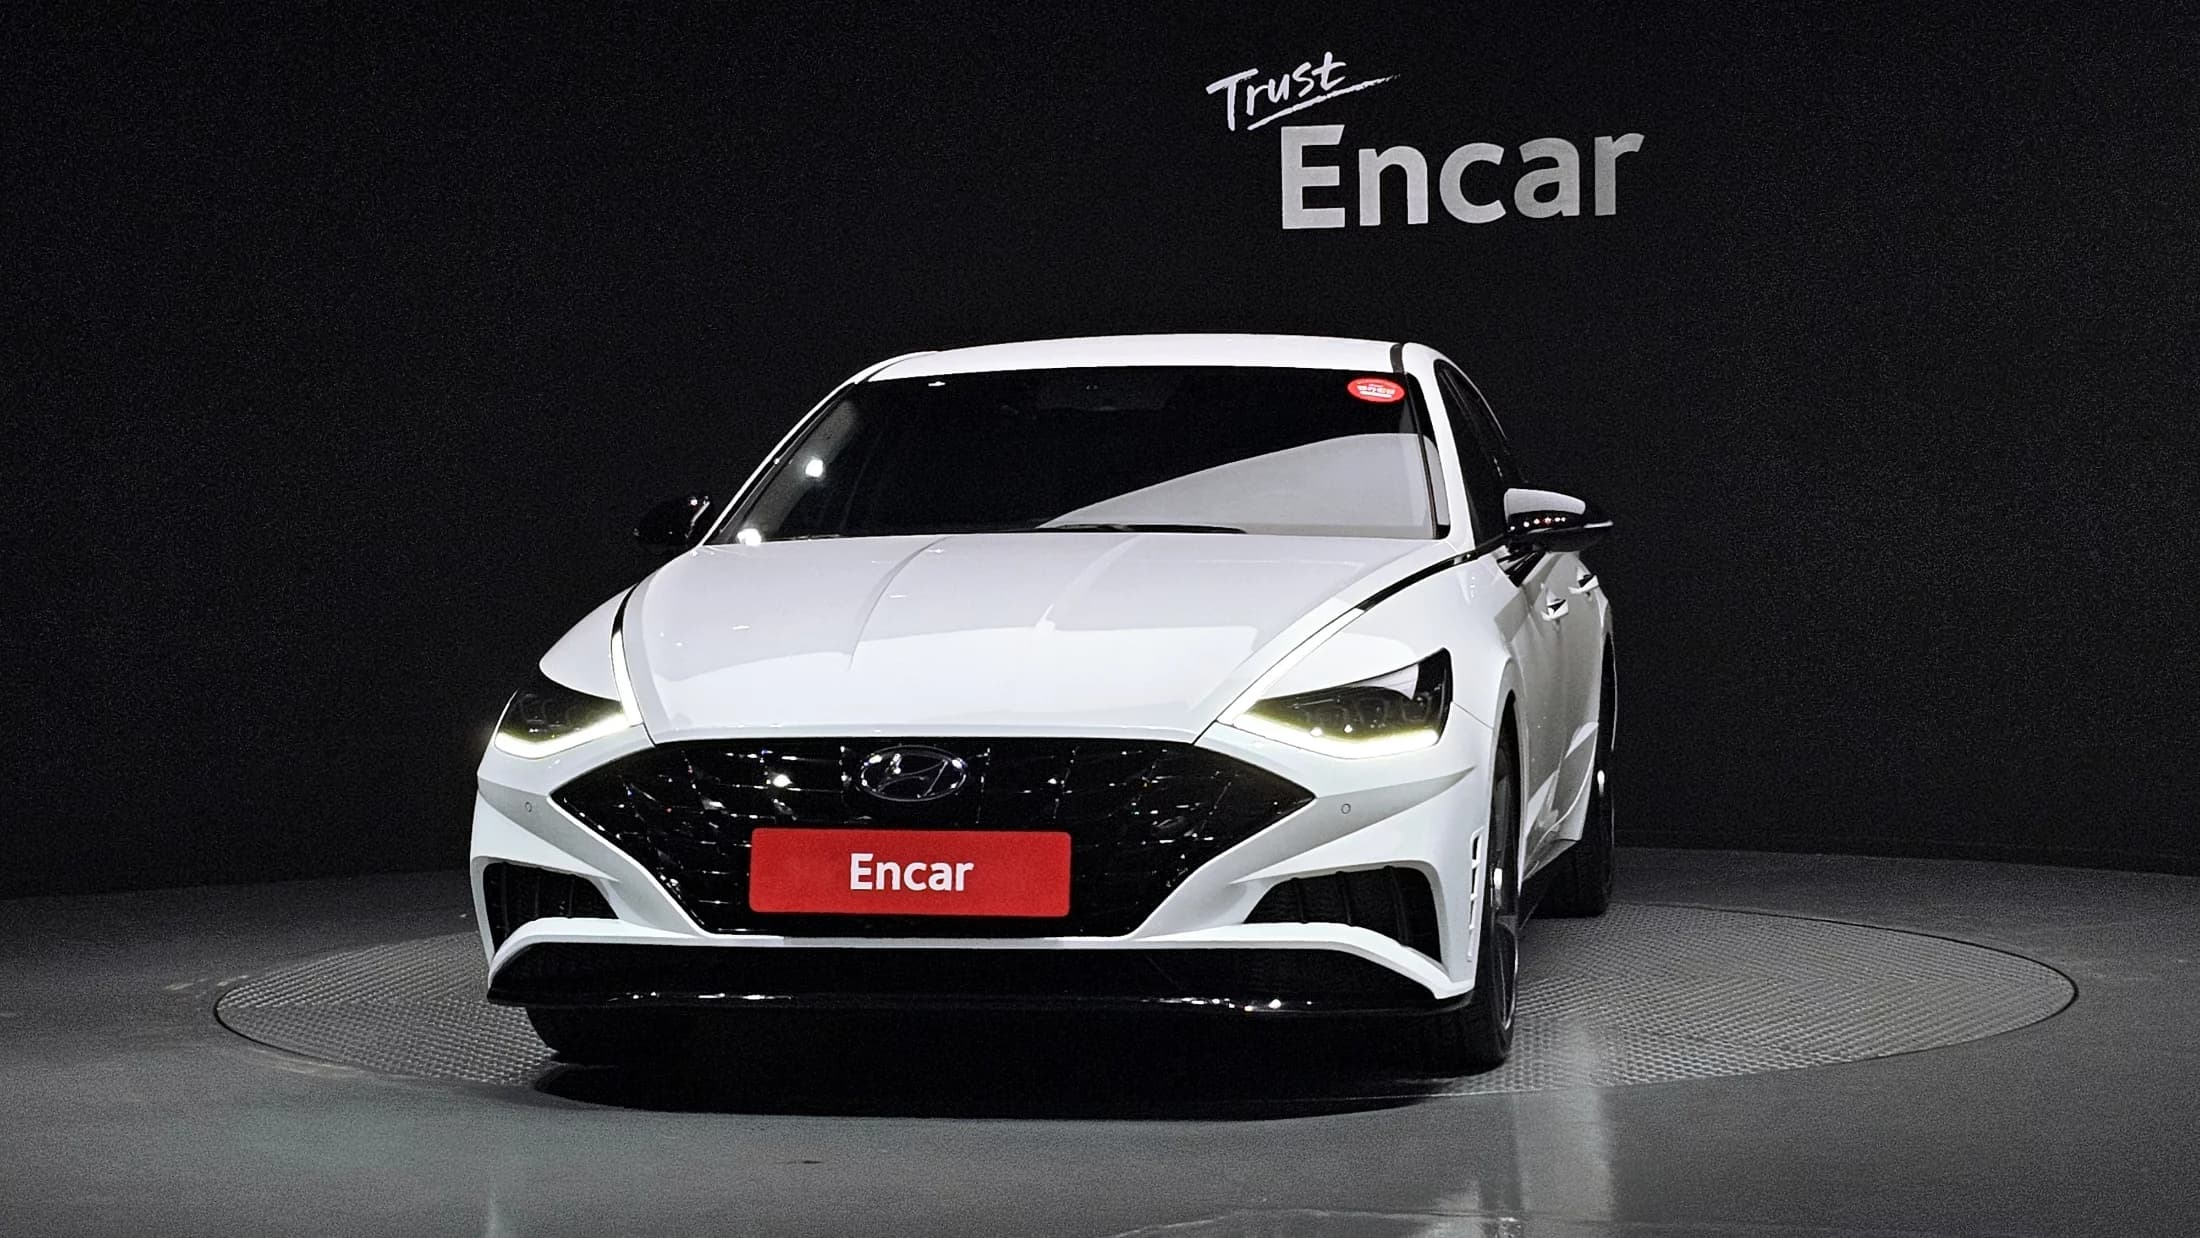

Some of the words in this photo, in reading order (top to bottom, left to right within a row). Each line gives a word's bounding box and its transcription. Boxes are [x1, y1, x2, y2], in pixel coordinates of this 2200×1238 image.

[1206, 51, 1347, 131] Trust
[1281, 124, 1645, 230] Encar
[849, 852, 974, 891] Encar
